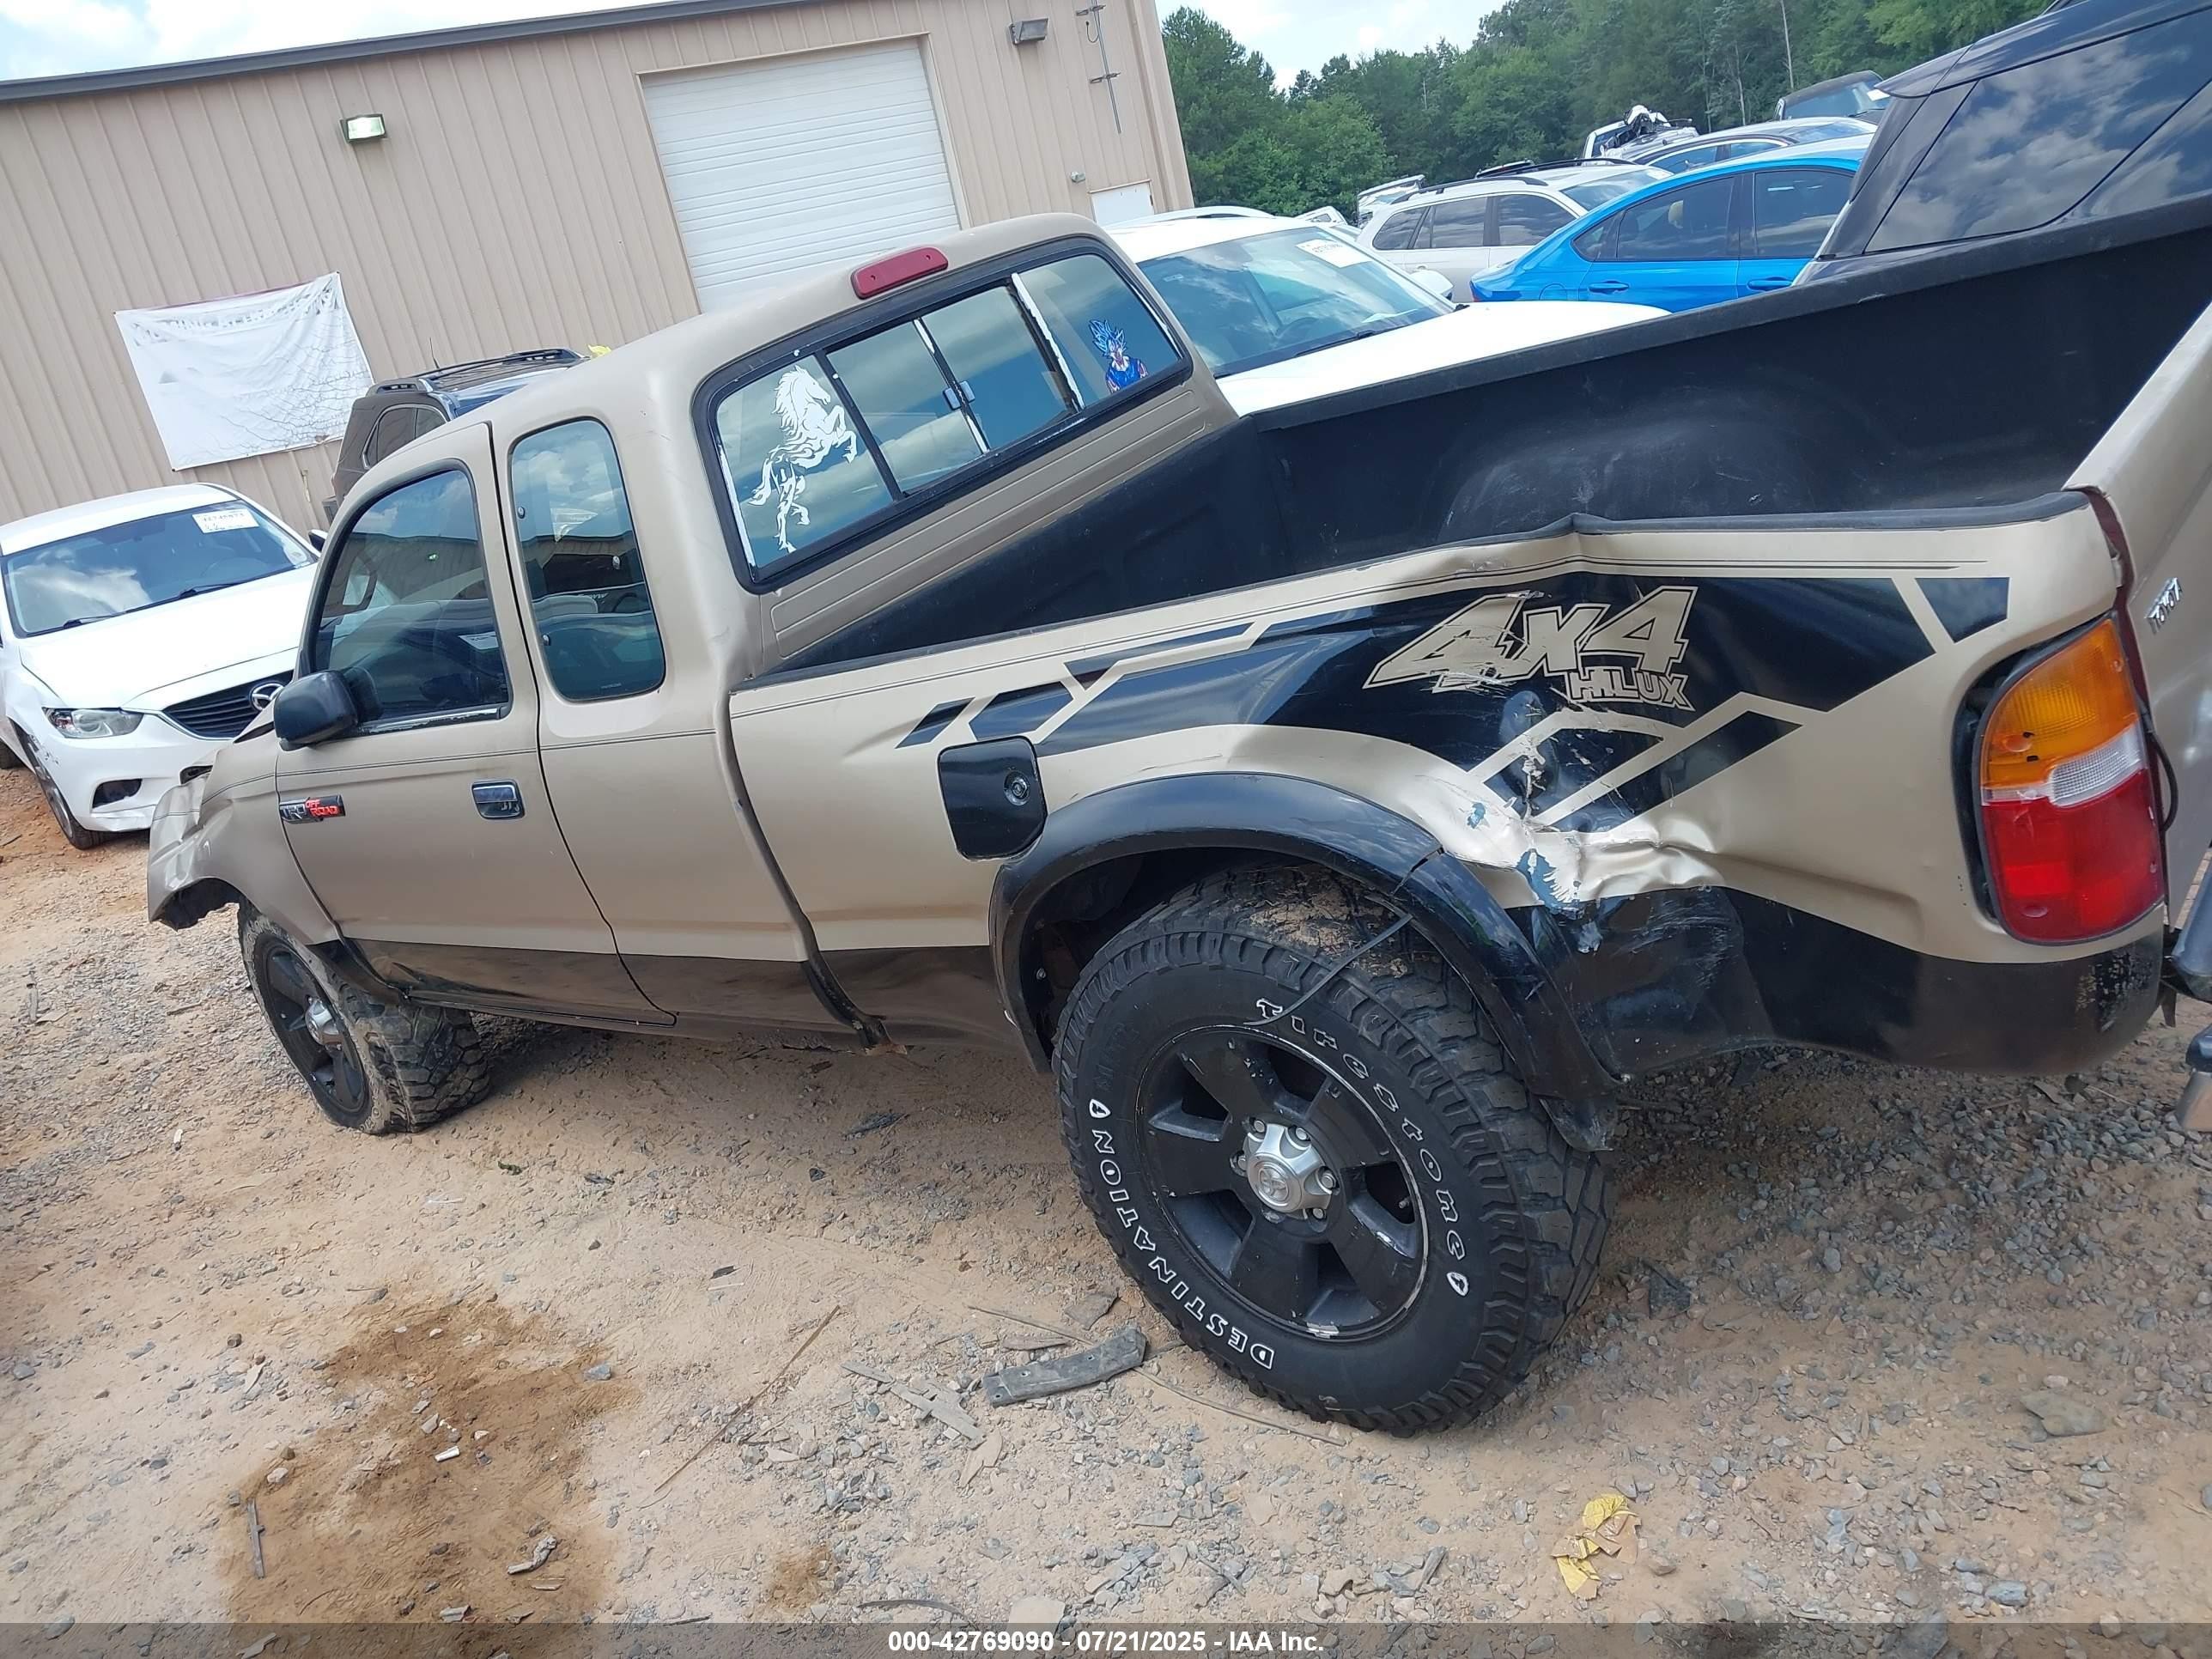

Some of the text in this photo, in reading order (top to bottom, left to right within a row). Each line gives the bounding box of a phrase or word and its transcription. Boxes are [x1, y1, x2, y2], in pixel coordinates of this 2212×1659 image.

[1565, 666, 1696, 712] HILUX
[305, 799, 320, 808] OFF
[309, 805, 339, 817] ROAD
[1092, 1127, 1276, 1370] DESTINATION
